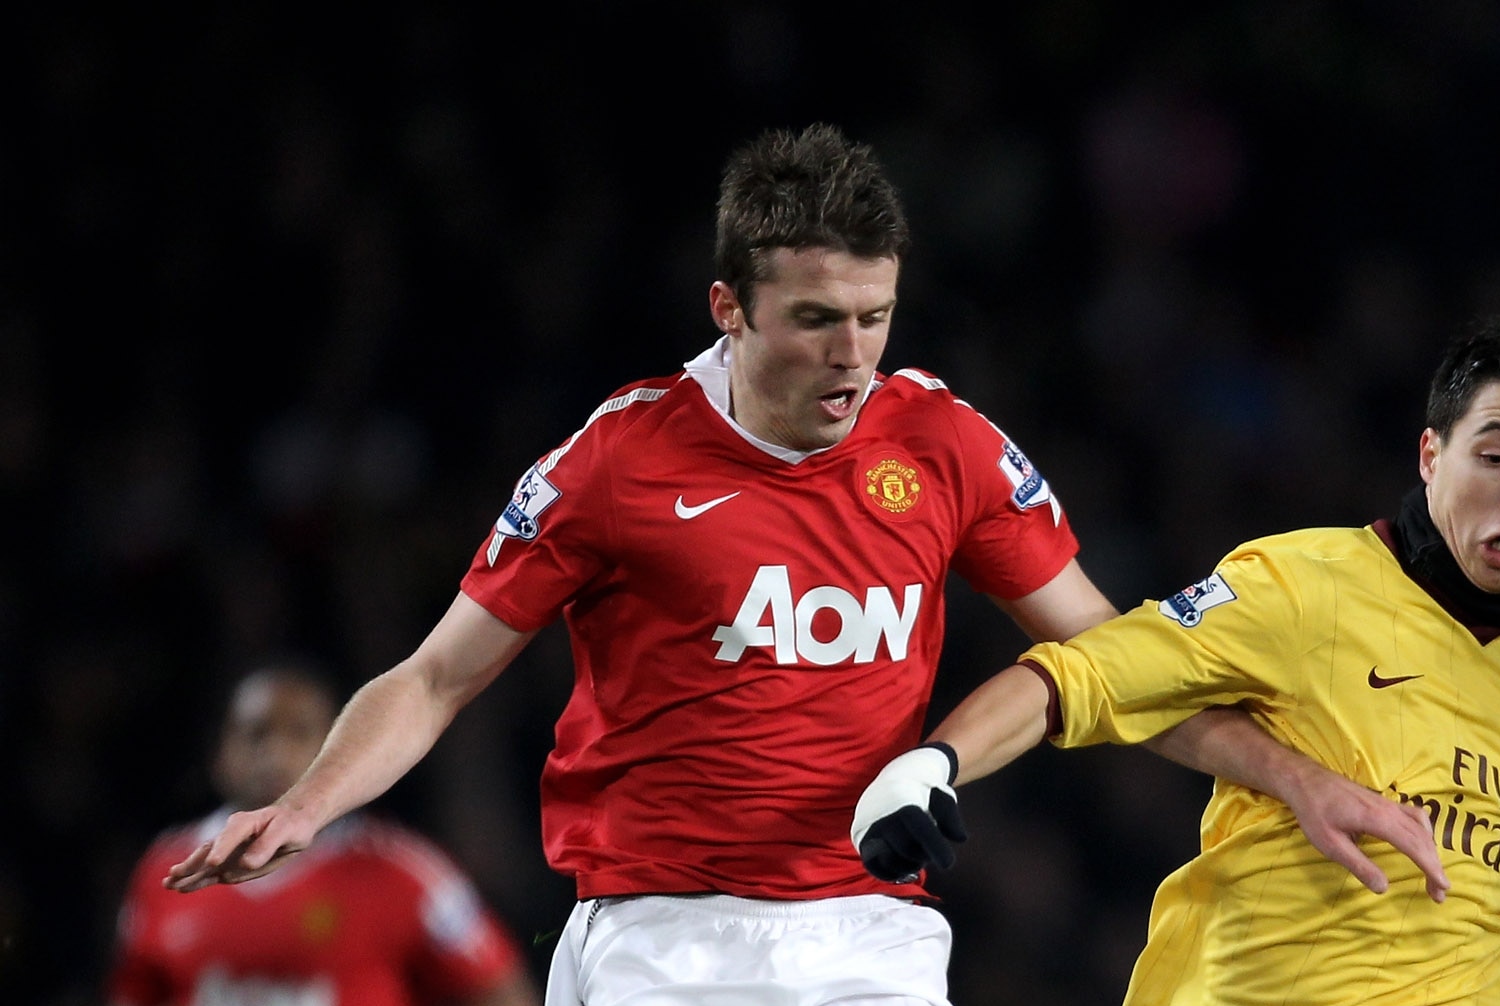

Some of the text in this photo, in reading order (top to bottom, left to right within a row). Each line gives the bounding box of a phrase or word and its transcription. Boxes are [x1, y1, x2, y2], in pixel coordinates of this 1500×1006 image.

[870, 463, 913, 481] MANCHESTER
[882, 499, 912, 508] UNITED
[711, 565, 923, 666] AON
